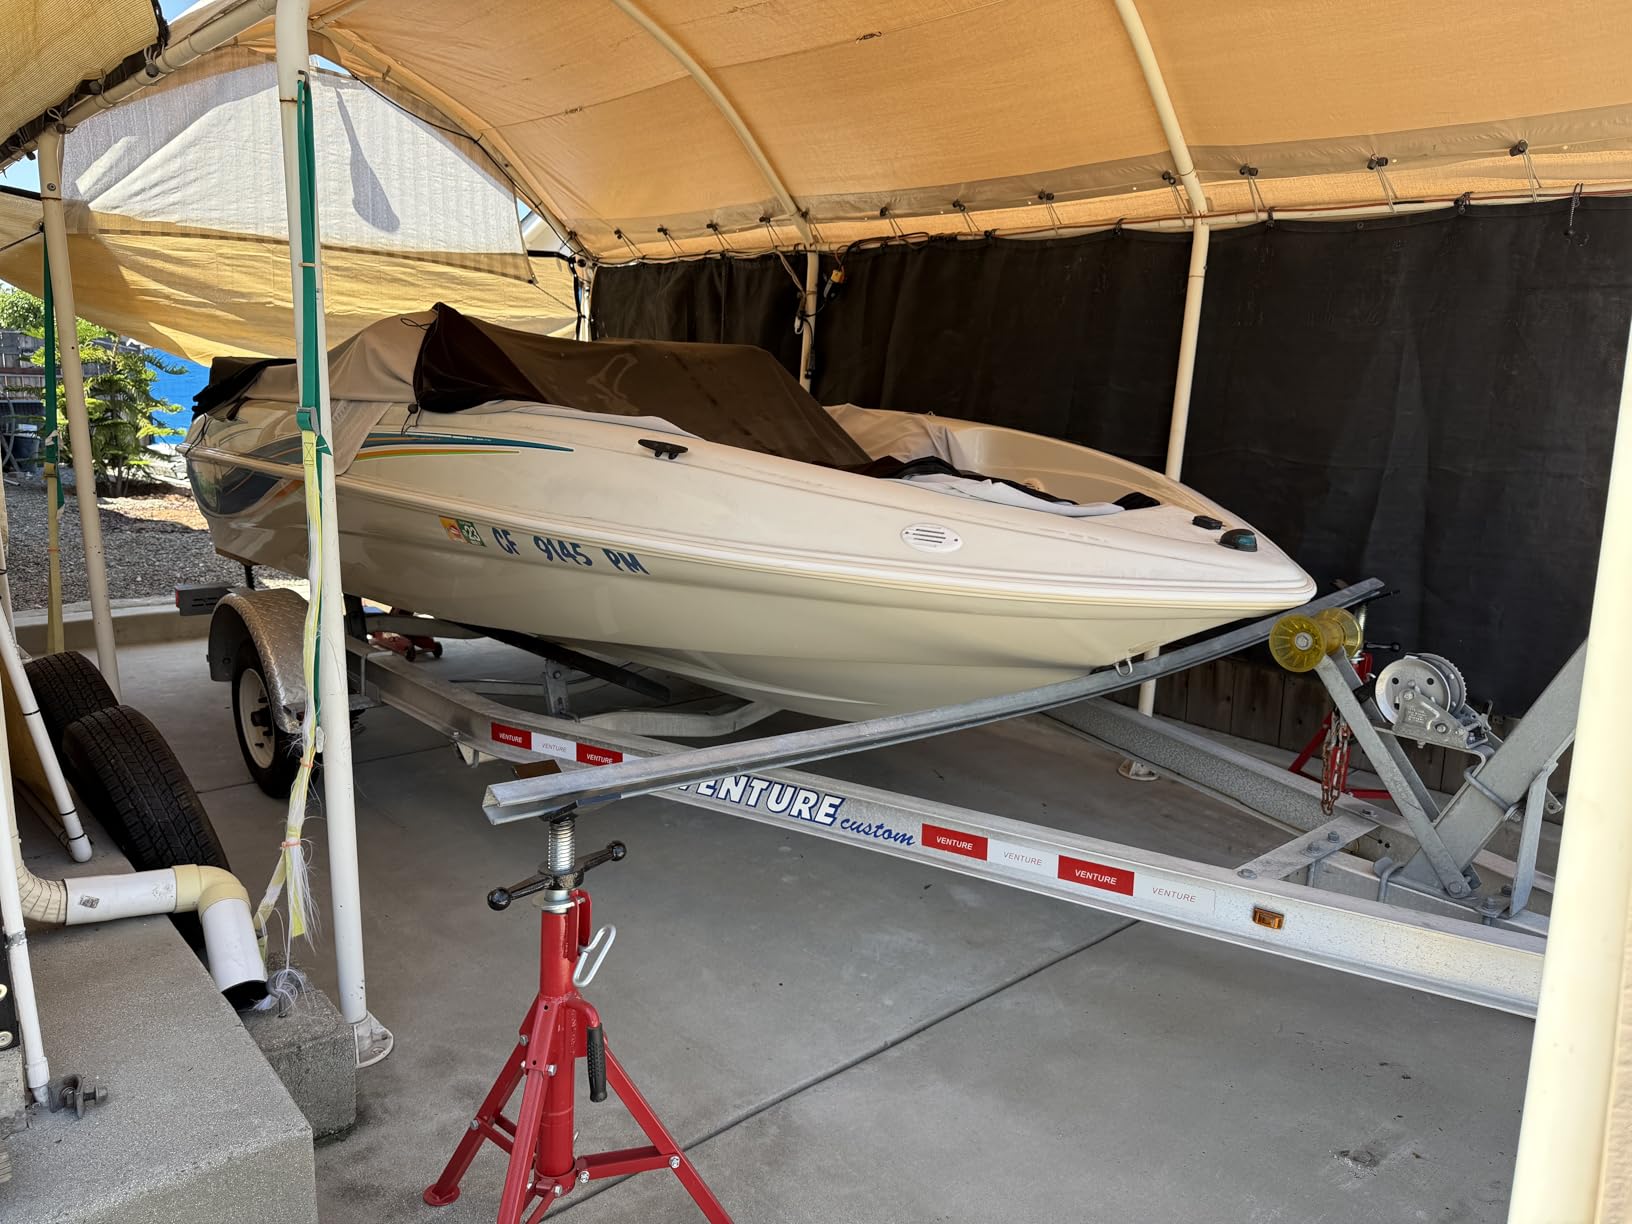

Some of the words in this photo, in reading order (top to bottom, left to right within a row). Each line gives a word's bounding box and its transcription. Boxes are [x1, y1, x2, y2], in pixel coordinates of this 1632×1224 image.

[464, 525, 480, 542] 23
[492, 527, 520, 556] CF
[533, 535, 593, 567] 9145
[602, 548, 650, 576] PM
[499, 732, 523, 744] VENTURE
[542, 743, 568, 753] VENTURE
[586, 753, 613, 765] VENTURE
[678, 775, 846, 826] ENTURE
[840, 817, 916, 846] custom
[936, 836, 973, 851] VENTURE
[1003, 851, 1043, 867] VENTURE
[1074, 868, 1118, 886] VENTURE
[1151, 886, 1197, 904] VENTURE
